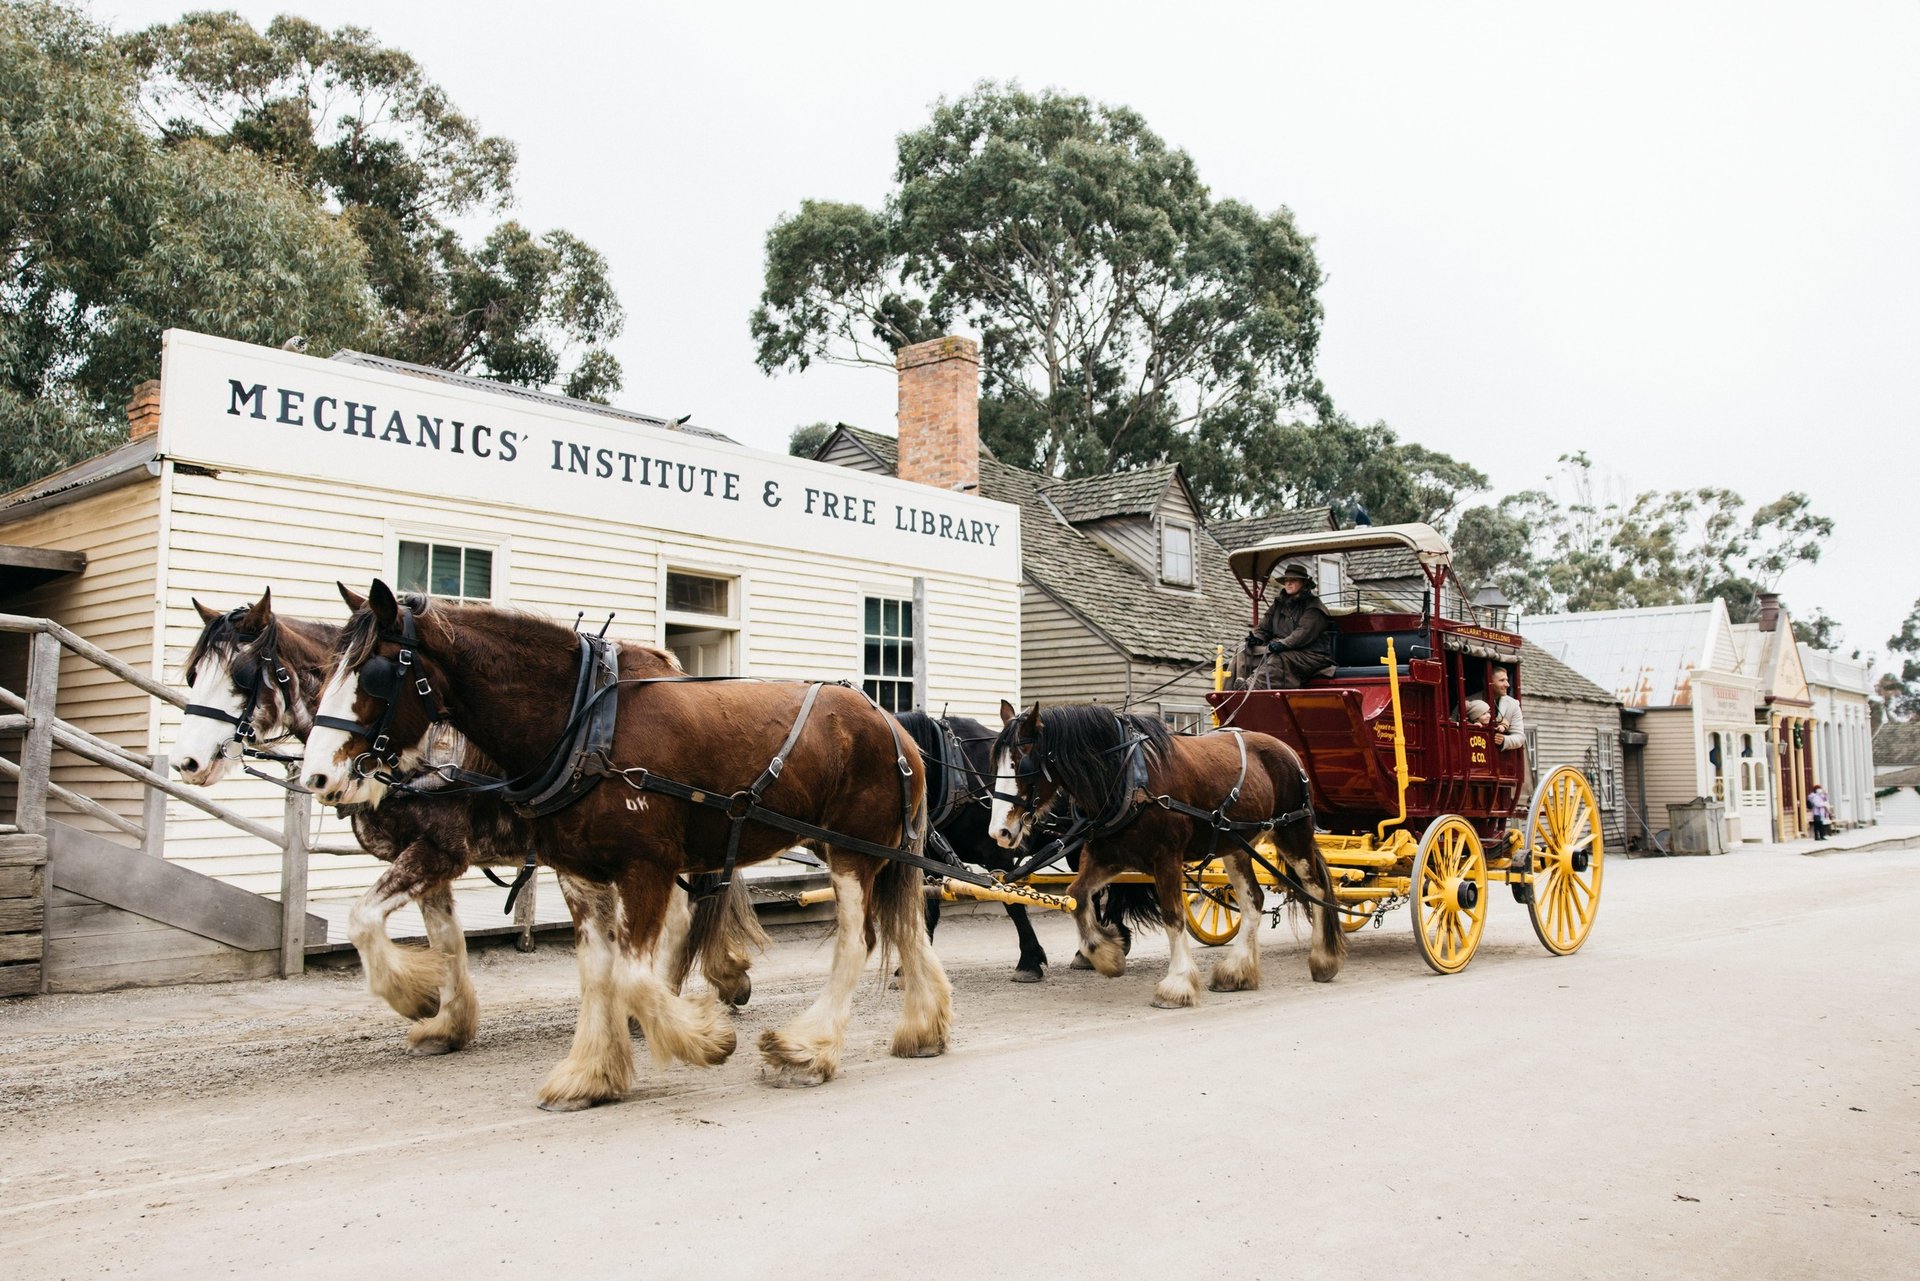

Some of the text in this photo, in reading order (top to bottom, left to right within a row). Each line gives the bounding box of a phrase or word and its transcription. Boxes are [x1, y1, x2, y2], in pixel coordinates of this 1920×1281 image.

[551, 439, 741, 502] INSTITUTE
[762, 480, 782, 508] &
[804, 487, 876, 526] FREE
[895, 505, 1000, 547] LIBRARY
[1470, 736, 1486, 749] COBB
[1471, 752, 1477, 763] &
